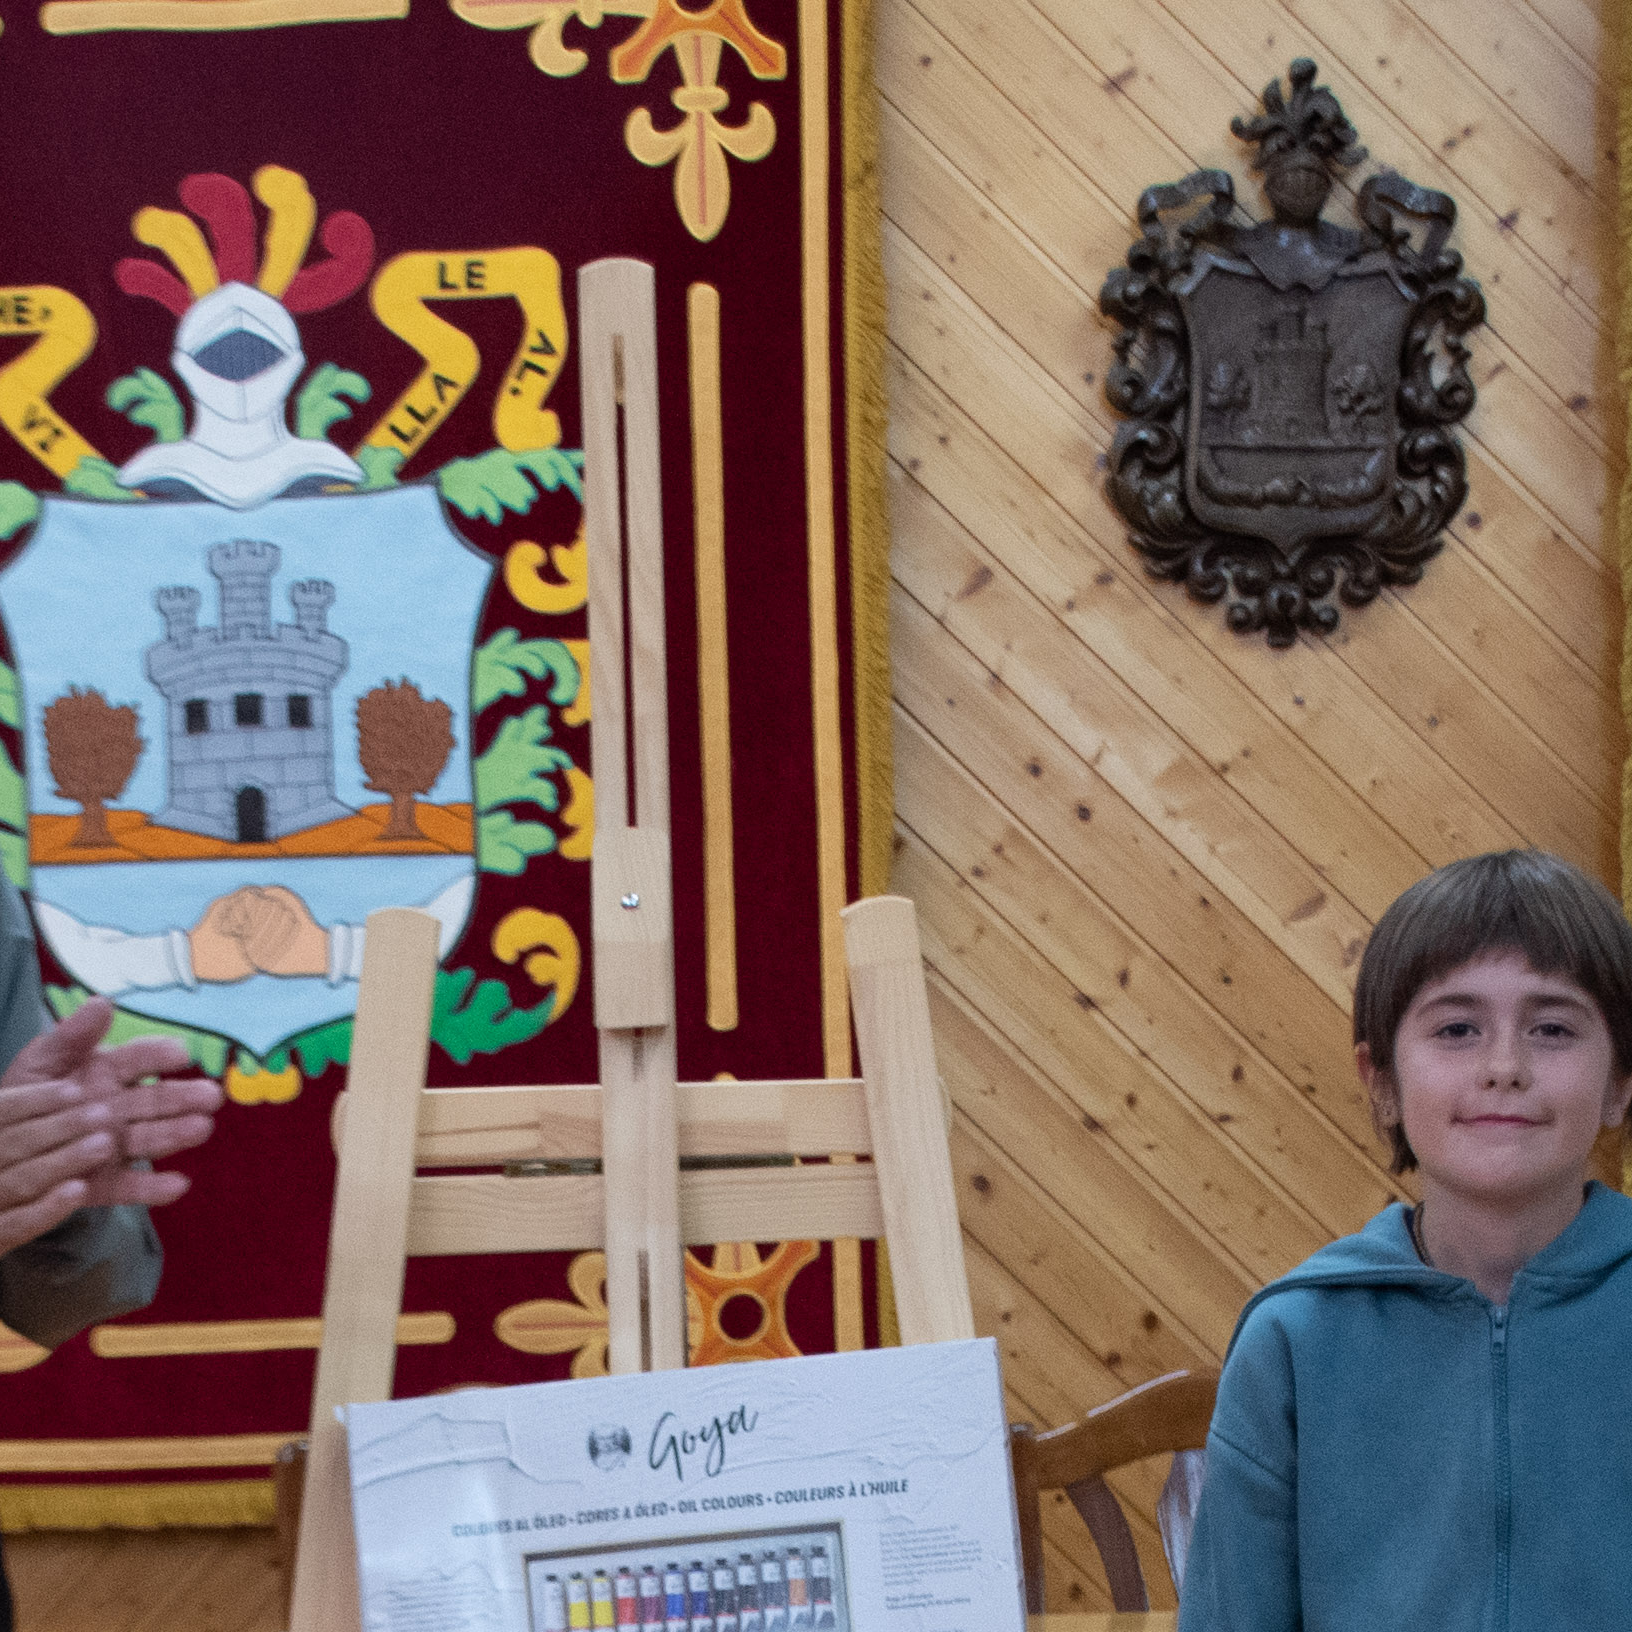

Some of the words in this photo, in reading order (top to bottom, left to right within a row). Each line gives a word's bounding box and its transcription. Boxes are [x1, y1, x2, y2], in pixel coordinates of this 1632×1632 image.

[438, 260, 485, 290] LE
[649, 1404, 760, 1483] Goya
[678, 1499, 699, 1514] OIL
[702, 1492, 764, 1512] COLOURS
[775, 1484, 845, 1506] COULEURS
[849, 1480, 858, 1498] À
[861, 1478, 911, 1498] L'HUILE
